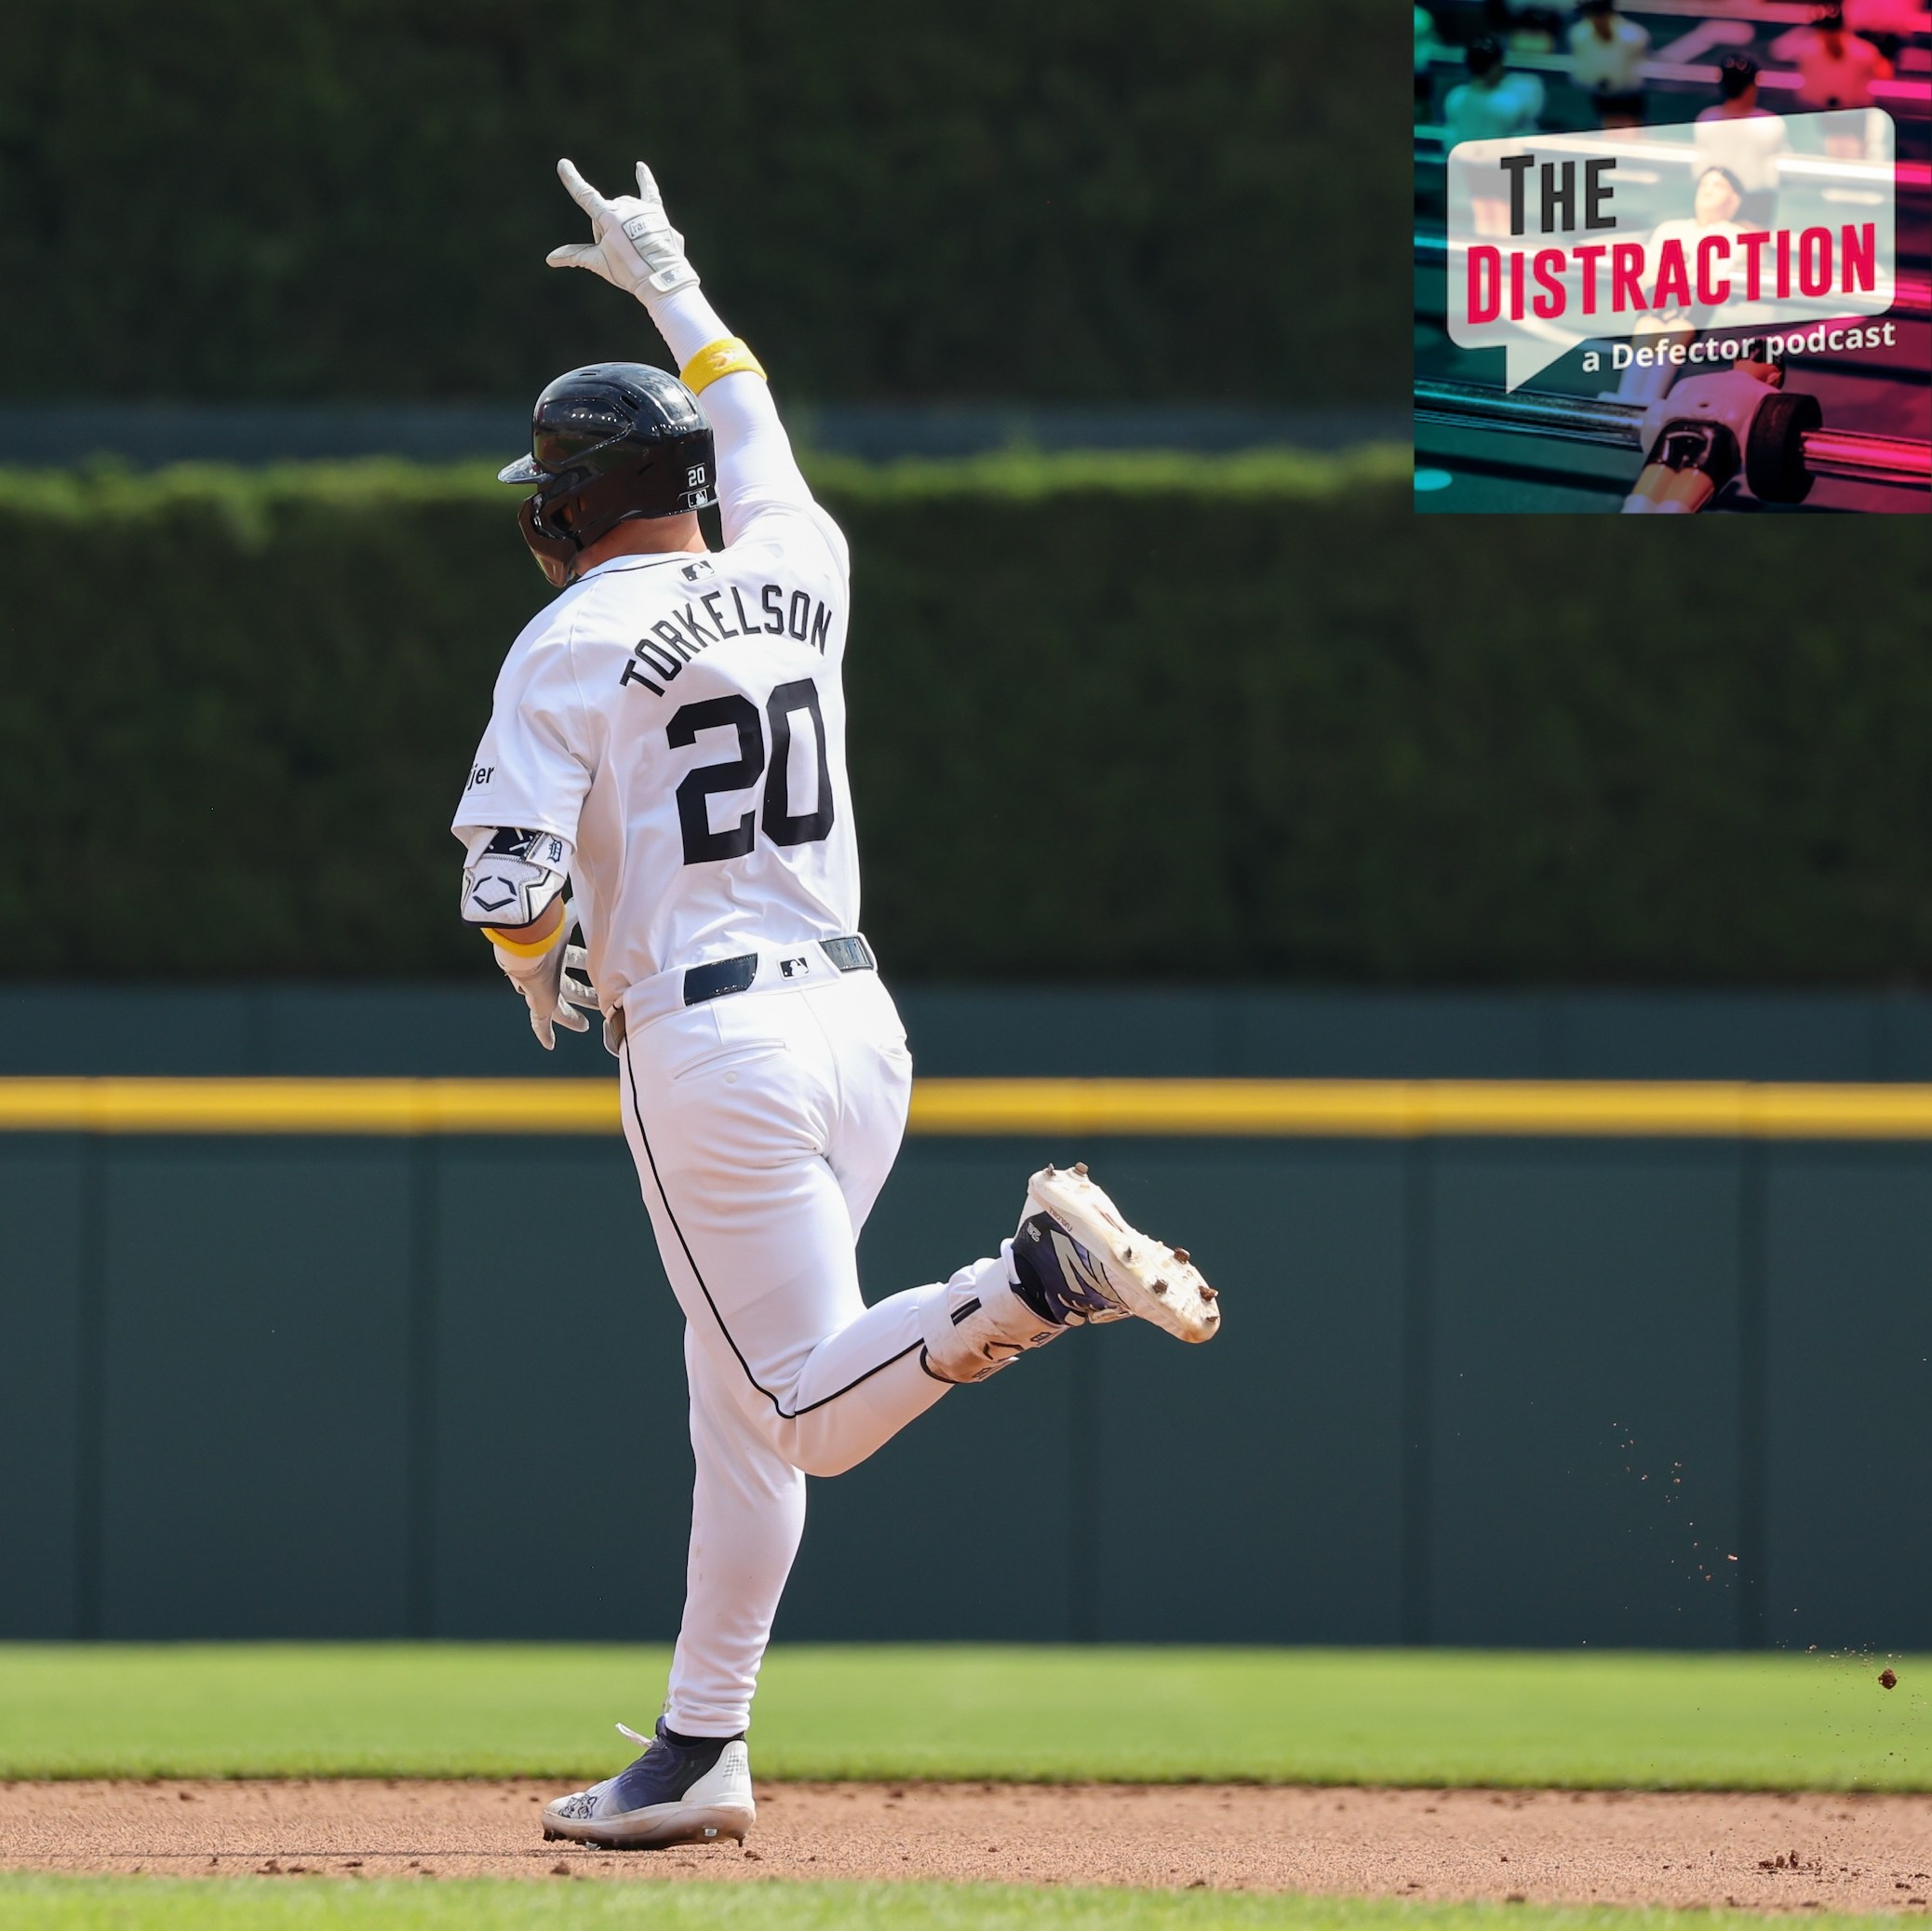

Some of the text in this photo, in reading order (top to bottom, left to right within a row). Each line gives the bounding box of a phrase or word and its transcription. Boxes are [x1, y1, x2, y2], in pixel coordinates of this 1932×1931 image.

[688, 466, 705, 487] 20
[619, 584, 833, 697] TORKELSON
[665, 677, 835, 865] 20
